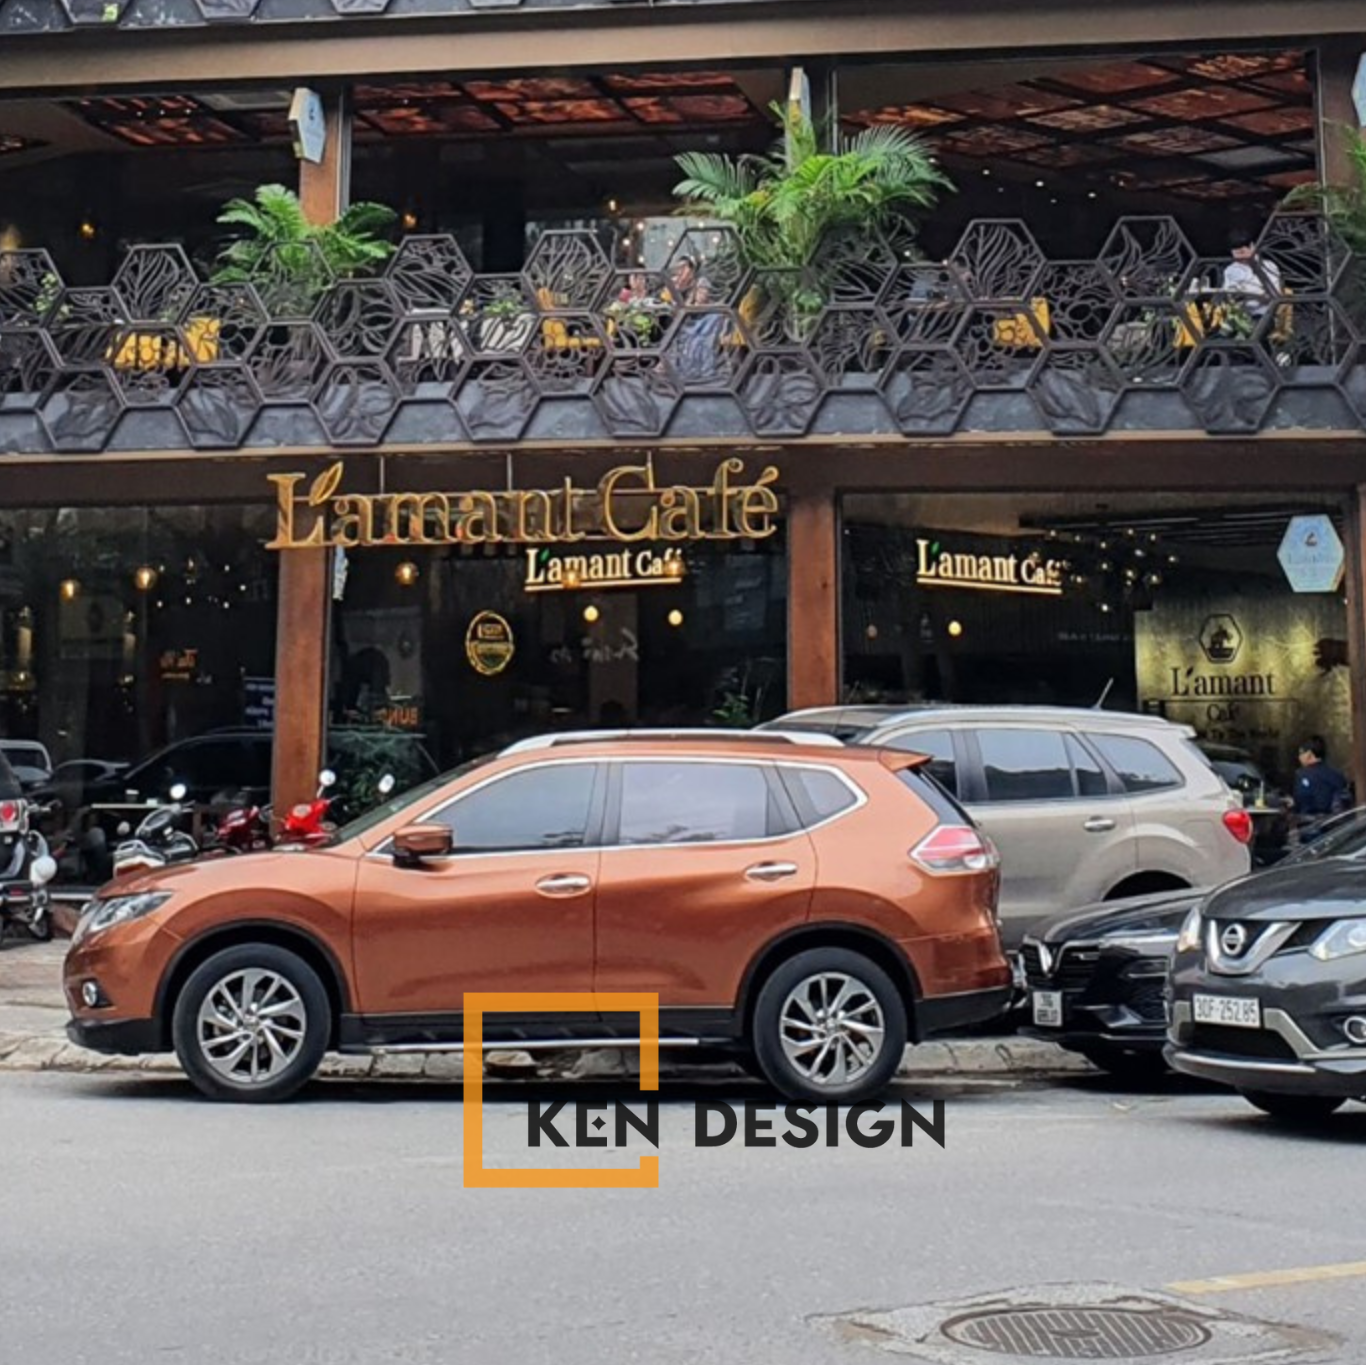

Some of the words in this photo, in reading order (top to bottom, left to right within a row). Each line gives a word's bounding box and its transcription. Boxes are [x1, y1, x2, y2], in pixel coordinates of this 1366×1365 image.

[265, 461, 588, 550] L'amant
[598, 457, 781, 542] Café
[524, 547, 633, 584] L'amant
[916, 538, 1018, 584] L'amant
[1170, 665, 1276, 696] L'amant
